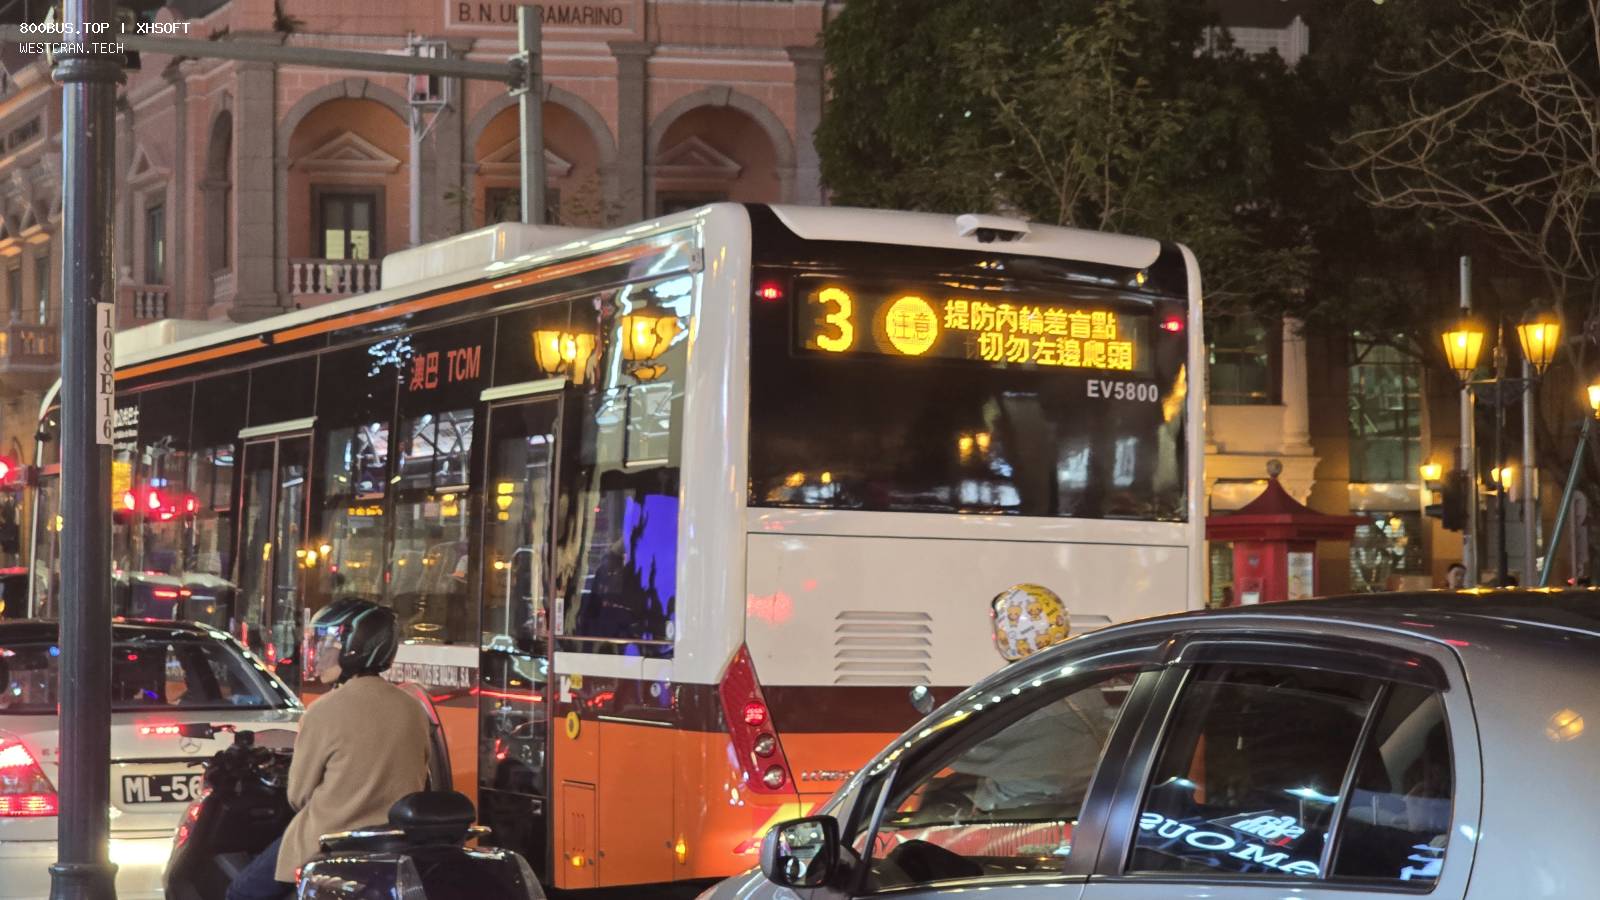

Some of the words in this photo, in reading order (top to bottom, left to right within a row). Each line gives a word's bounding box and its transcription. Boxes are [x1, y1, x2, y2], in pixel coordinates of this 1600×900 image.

[458, 3, 474, 22] B.
[479, 4, 496, 23] N.
[500, 4, 623, 26] ULRAMARINO
[816, 287, 854, 353] 3
[409, 351, 440, 392] 澳巴
[447, 344, 481, 383] TCM
[976, 331, 1133, 371] 切勿左邊爬頭
[1086, 378, 1159, 402] EV5800
